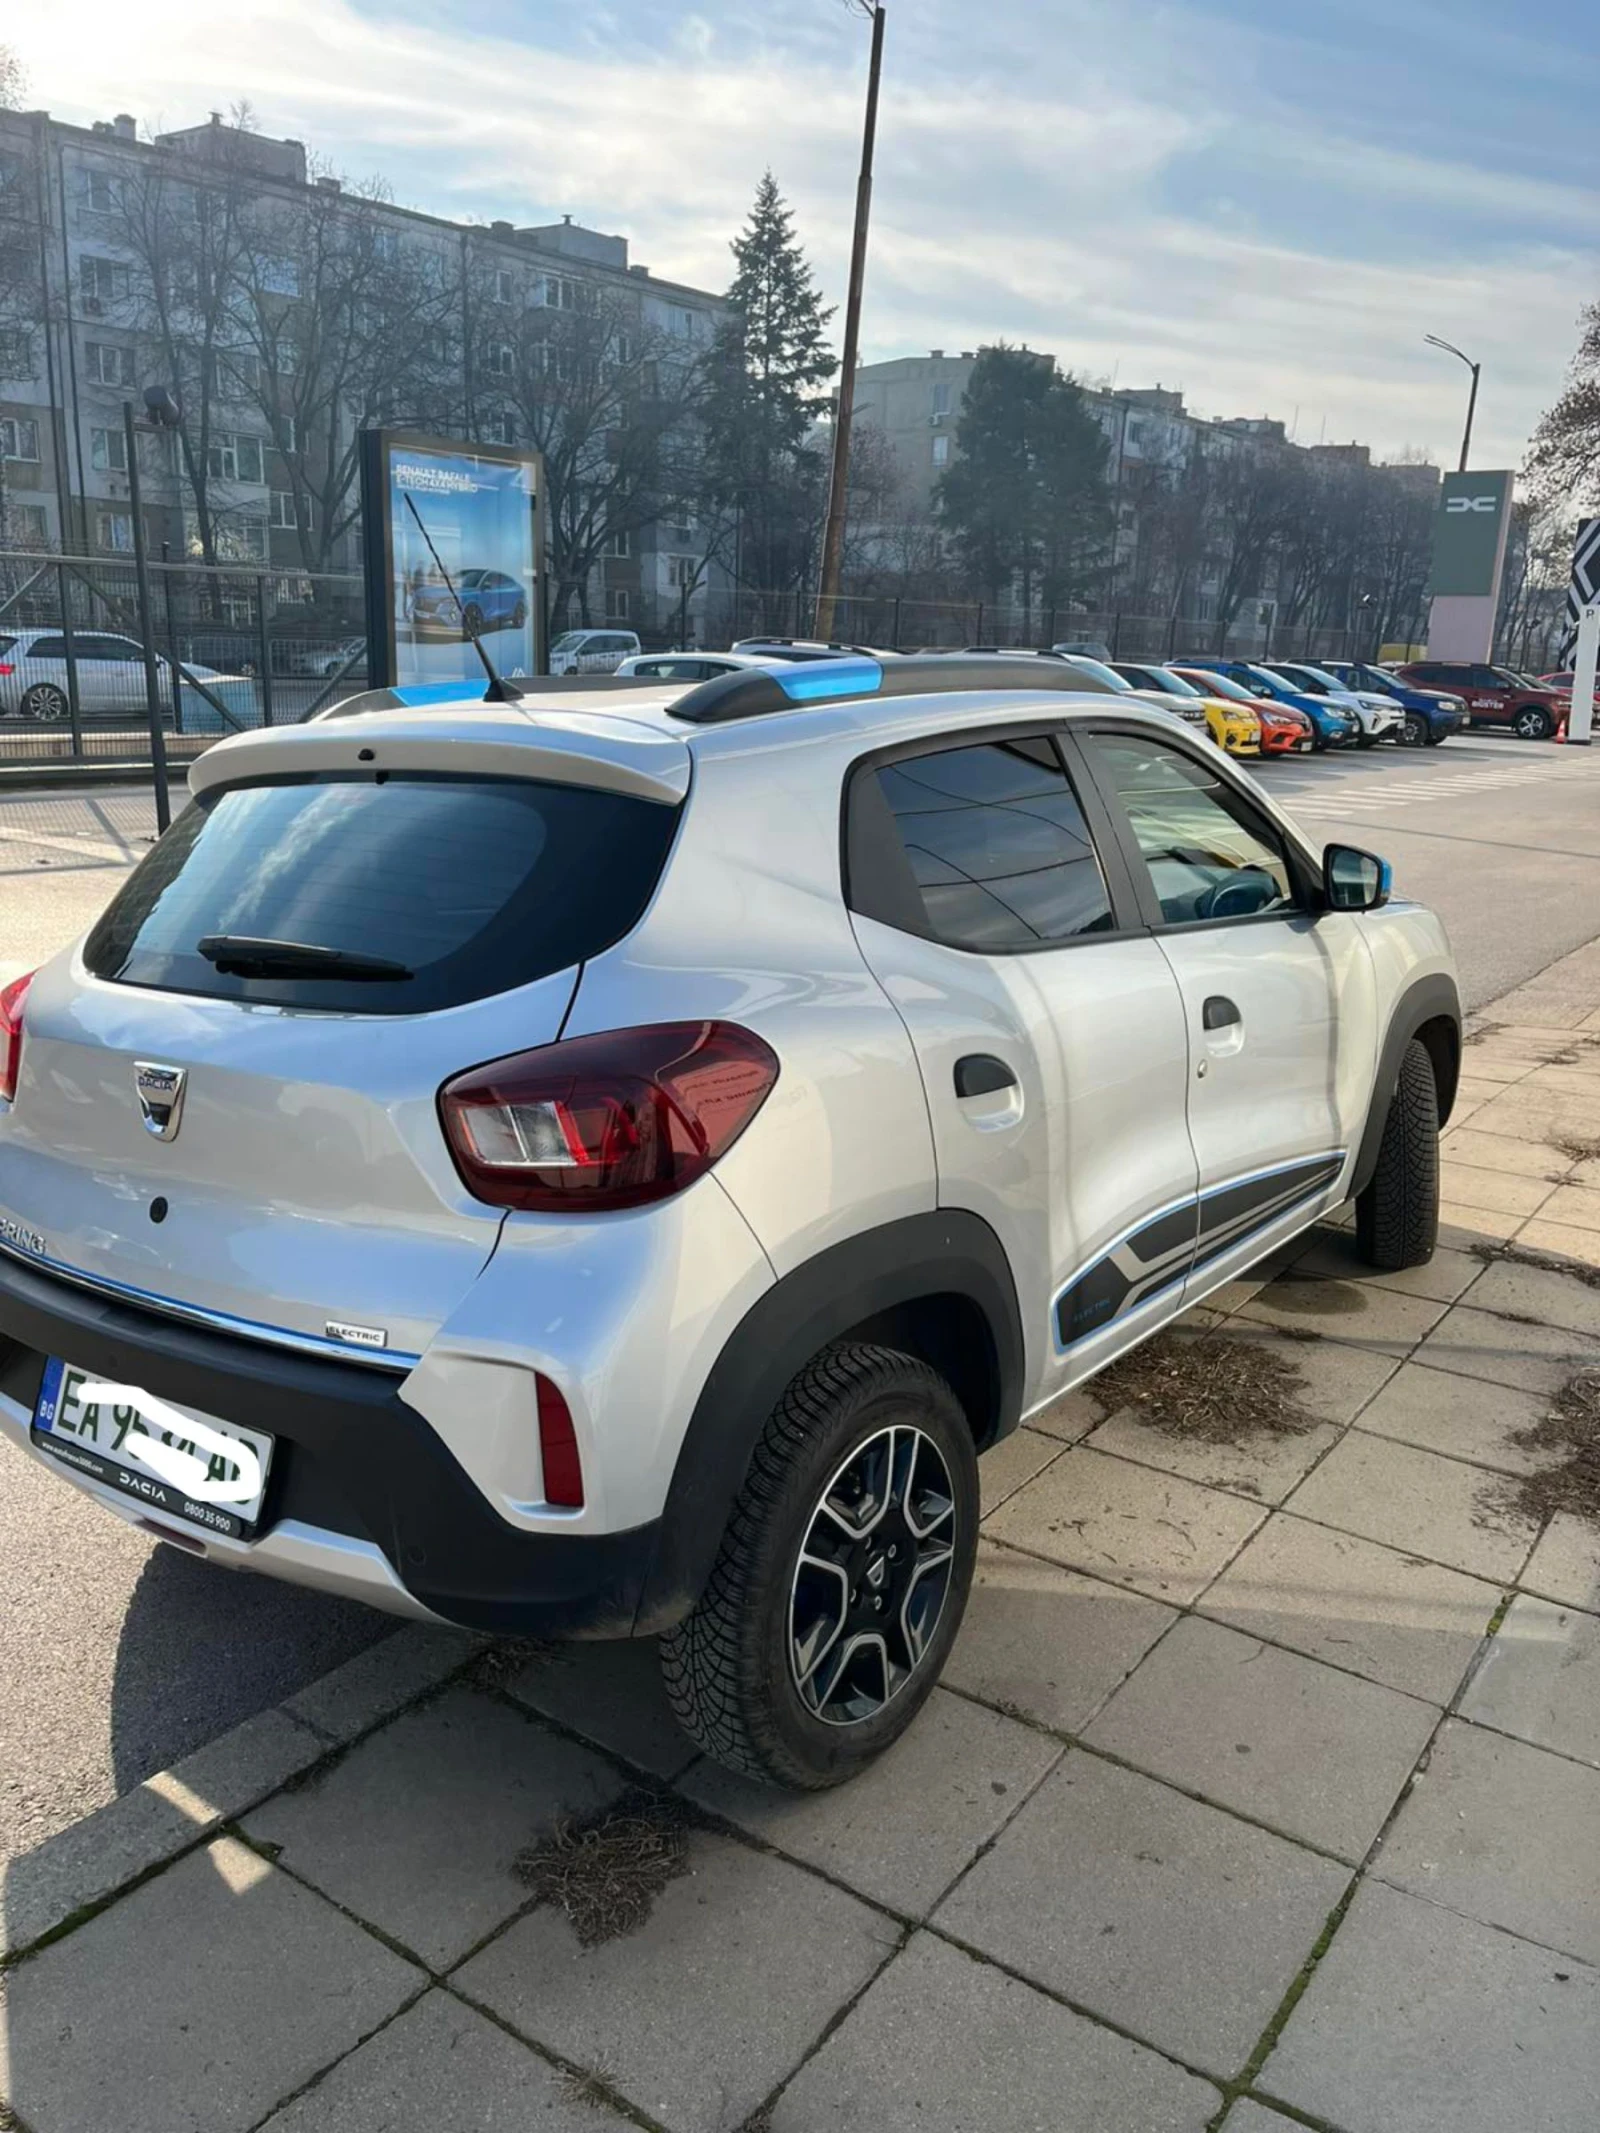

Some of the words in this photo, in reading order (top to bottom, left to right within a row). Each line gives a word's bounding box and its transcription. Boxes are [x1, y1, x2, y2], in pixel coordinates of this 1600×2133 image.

[138, 1075, 173, 1091] DACIA
[328, 1326, 381, 1342] ELECTRIC
[39, 1398, 55, 1421] BG
[119, 1471, 167, 1502] DACIA
[183, 1501, 205, 1519] 0800
[204, 1510, 216, 1524] 35
[215, 1514, 231, 1532] 900
